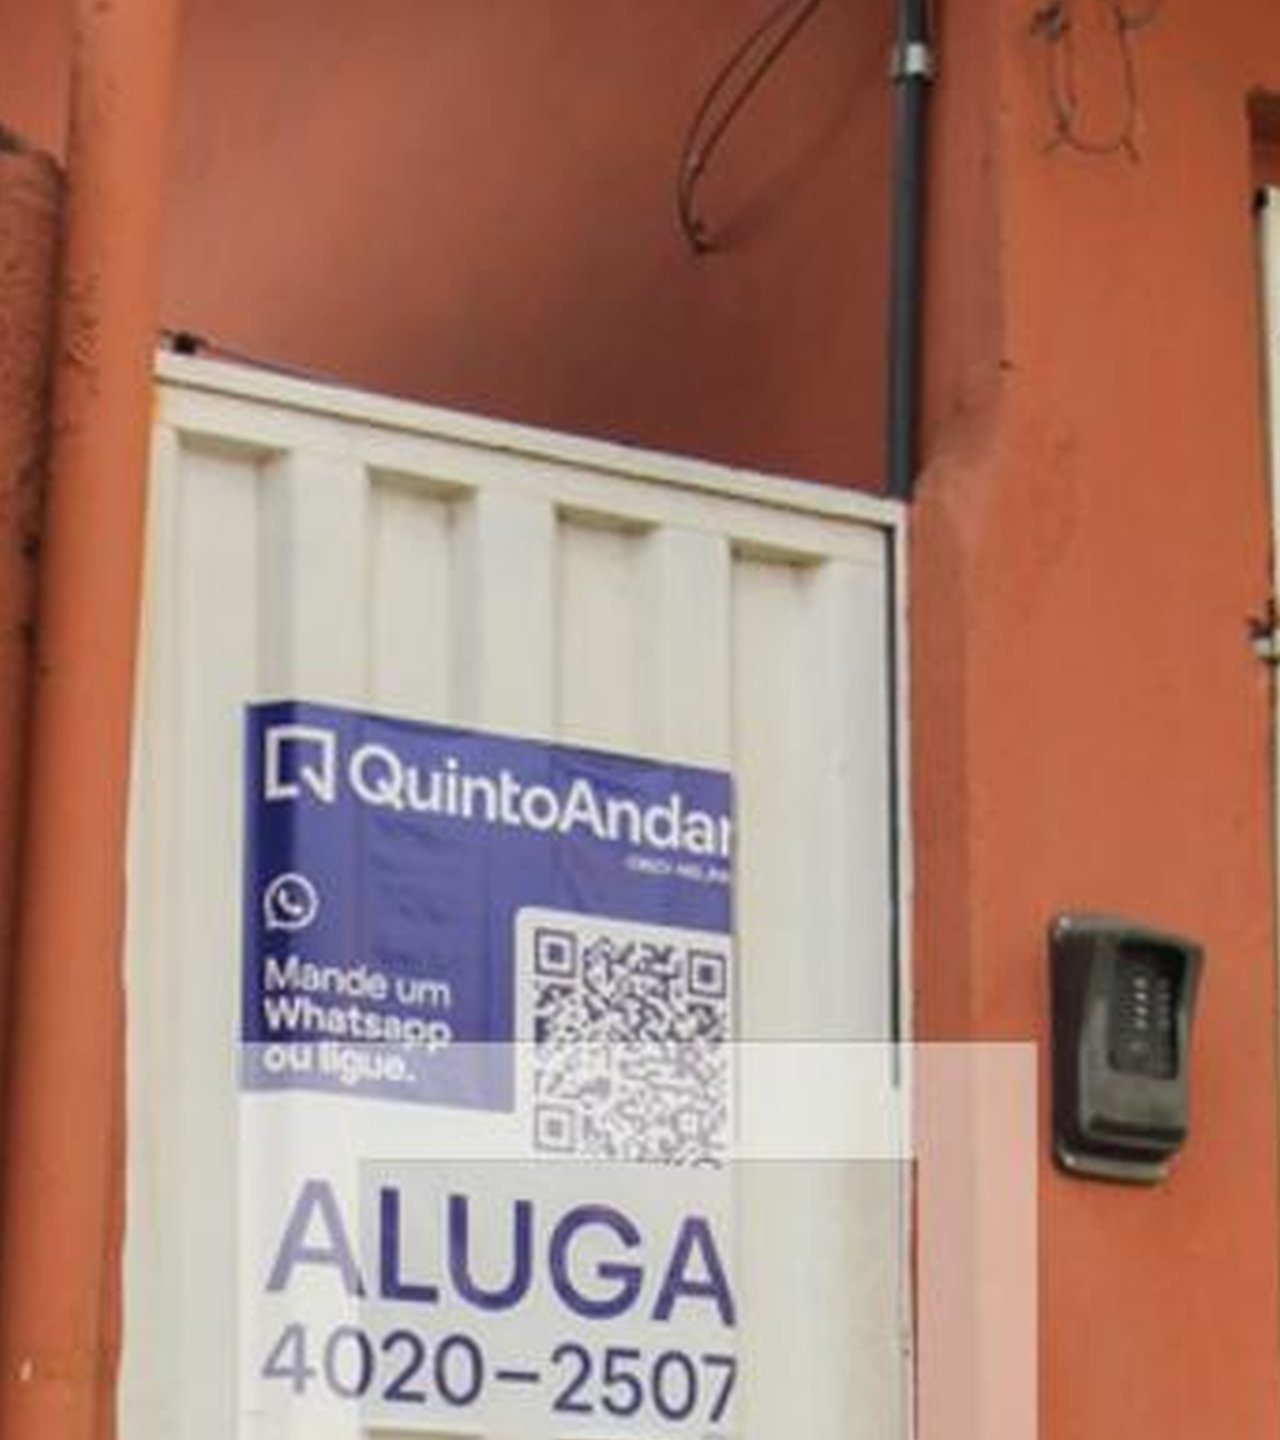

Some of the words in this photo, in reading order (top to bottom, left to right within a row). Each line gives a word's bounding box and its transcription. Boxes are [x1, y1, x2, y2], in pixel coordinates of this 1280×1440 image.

[263, 954, 389, 1000] Mande
[395, 977, 451, 1008] um
[263, 996, 452, 1052] Whatsapp
[263, 1044, 312, 1072] ou
[318, 1037, 417, 1086] ligue.
[264, 1178, 736, 1328] ALUGA
[261, 1323, 738, 1423] 4020-2507
